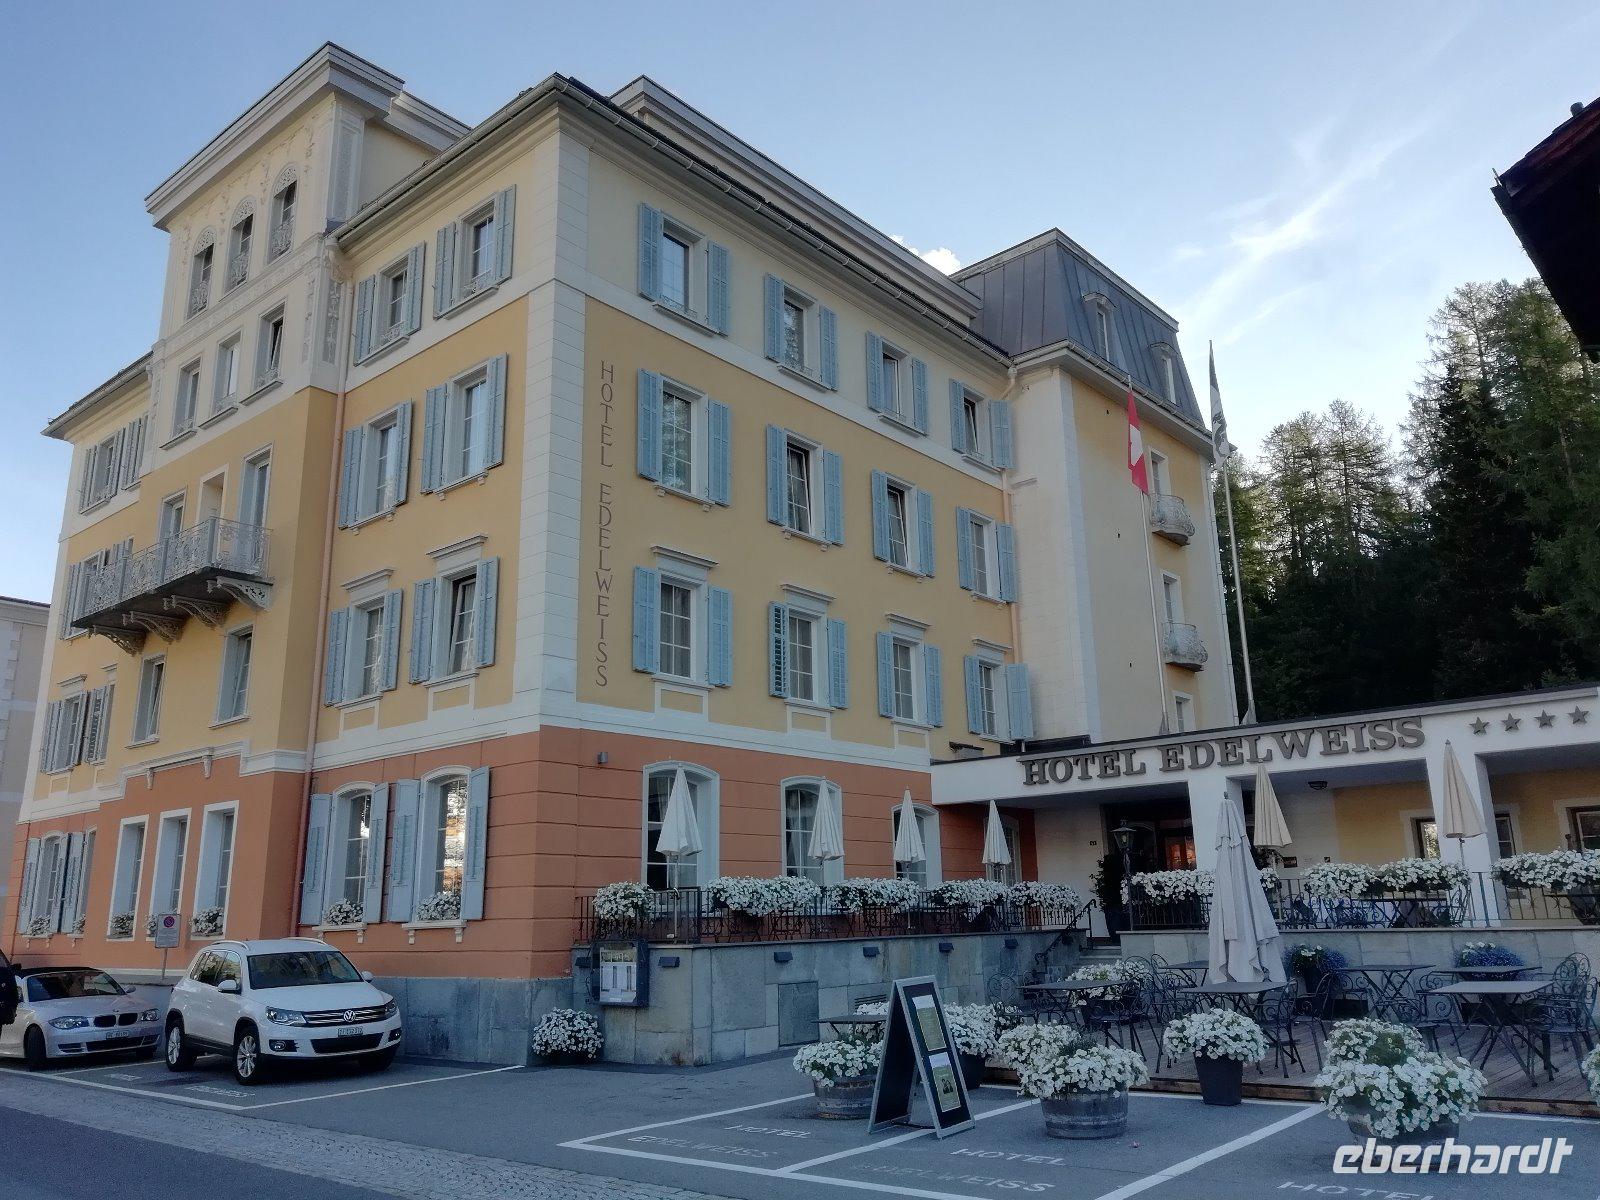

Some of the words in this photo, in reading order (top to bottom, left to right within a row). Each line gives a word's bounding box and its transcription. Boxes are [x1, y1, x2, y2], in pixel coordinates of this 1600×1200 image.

[600, 359, 614, 468] HOTEL
[595, 482, 614, 688] EDELWEISS
[1018, 749, 1147, 786] HOTEL
[1159, 716, 1427, 773] EDELWEISS
[950, 1148, 1067, 1166] HOTEL
